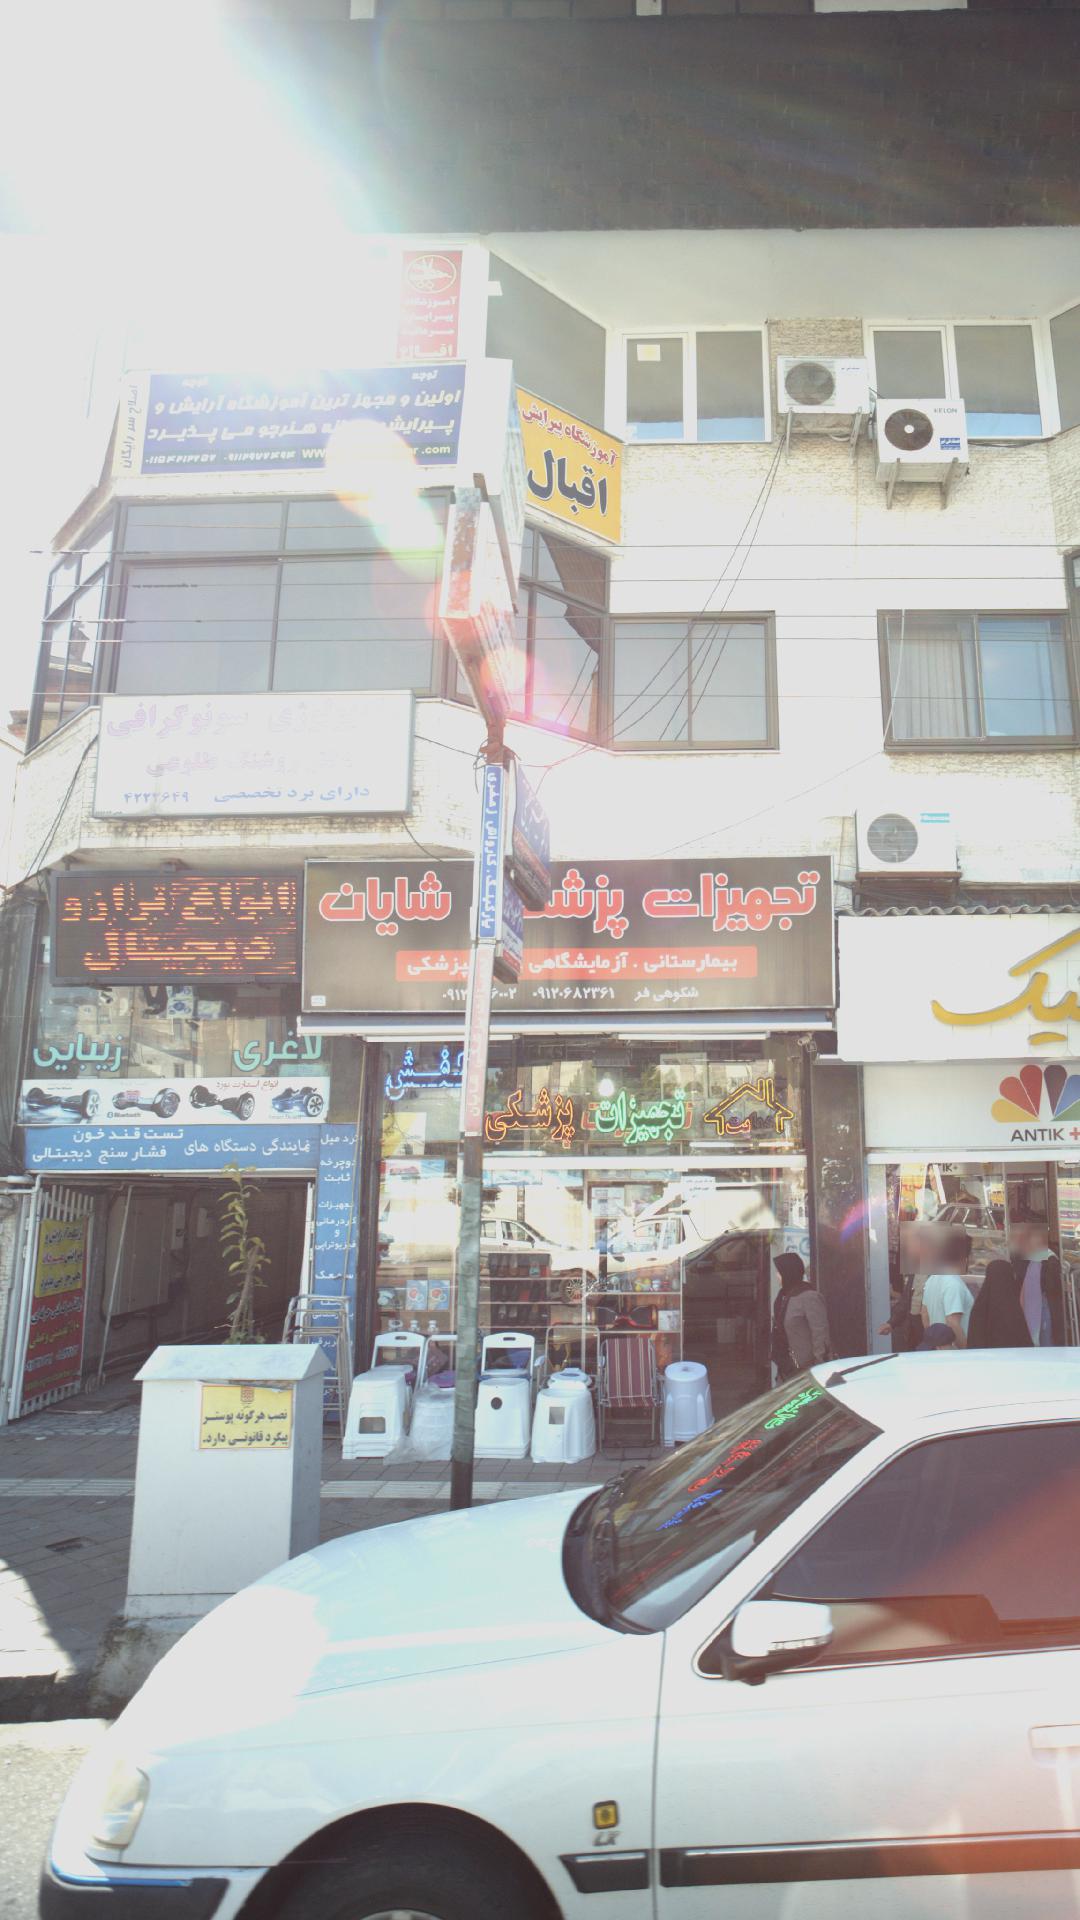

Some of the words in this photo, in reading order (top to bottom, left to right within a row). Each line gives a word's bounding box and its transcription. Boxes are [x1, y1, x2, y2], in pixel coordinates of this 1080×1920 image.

[168, 394, 225, 415] آرایش
[226, 392, 308, 412] آموزشگاه
[310, 393, 351, 411] ترین
[352, 392, 397, 409] مجهز
[400, 394, 411, 408] و
[414, 389, 461, 408] اولین
[154, 402, 165, 416] و
[147, 423, 218, 444] پذیرد
[221, 424, 256, 441] می
[259, 419, 317, 438] هنرجو
[564, 425, 618, 468] آموزشگاه
[527, 449, 608, 515] اقبال
[106, 701, 249, 739] سونوگرافی
[213, 785, 282, 804] تخصصی
[320, 785, 371, 801] دارای
[318, 869, 453, 936] شایان
[642, 869, 820, 933] تجهیزات
[528, 951, 629, 974] آزمایشگاهی
[643, 953, 738, 973] بیمارستانی
[532, 985, 616, 1000] ۰۹۱۲۰۶۸۲۳۶۱
[653, 986, 700, 1003] شکوهی
[33, 1033, 123, 1072] زیبایی
[233, 1030, 323, 1072] لاغری
[485, 1086, 576, 1150] پزشکی
[594, 1088, 690, 1145] تجهیزات
[73, 1128, 105, 1143] خون
[108, 1127, 141, 1140] قند
[144, 1128, 184, 1140] تست
[1010, 1127, 1065, 1142] ANTIK
[131, 1145, 167, 1161] فشار
[184, 1139, 208, 1156] های
[214, 1138, 257, 1152] دستگاه
[262, 1138, 311, 1156] نمایندگی
[32, 1147, 92, 1163] دیجیتالی
[98, 1147, 128, 1164] سنج
[316, 1215, 357, 1227] کردرمانی
[334, 1228, 341, 1238] و
[202, 1411, 234, 1425] پوستر
[268, 1409, 288, 1422] نصب
[228, 1430, 263, 1446] قانونی
